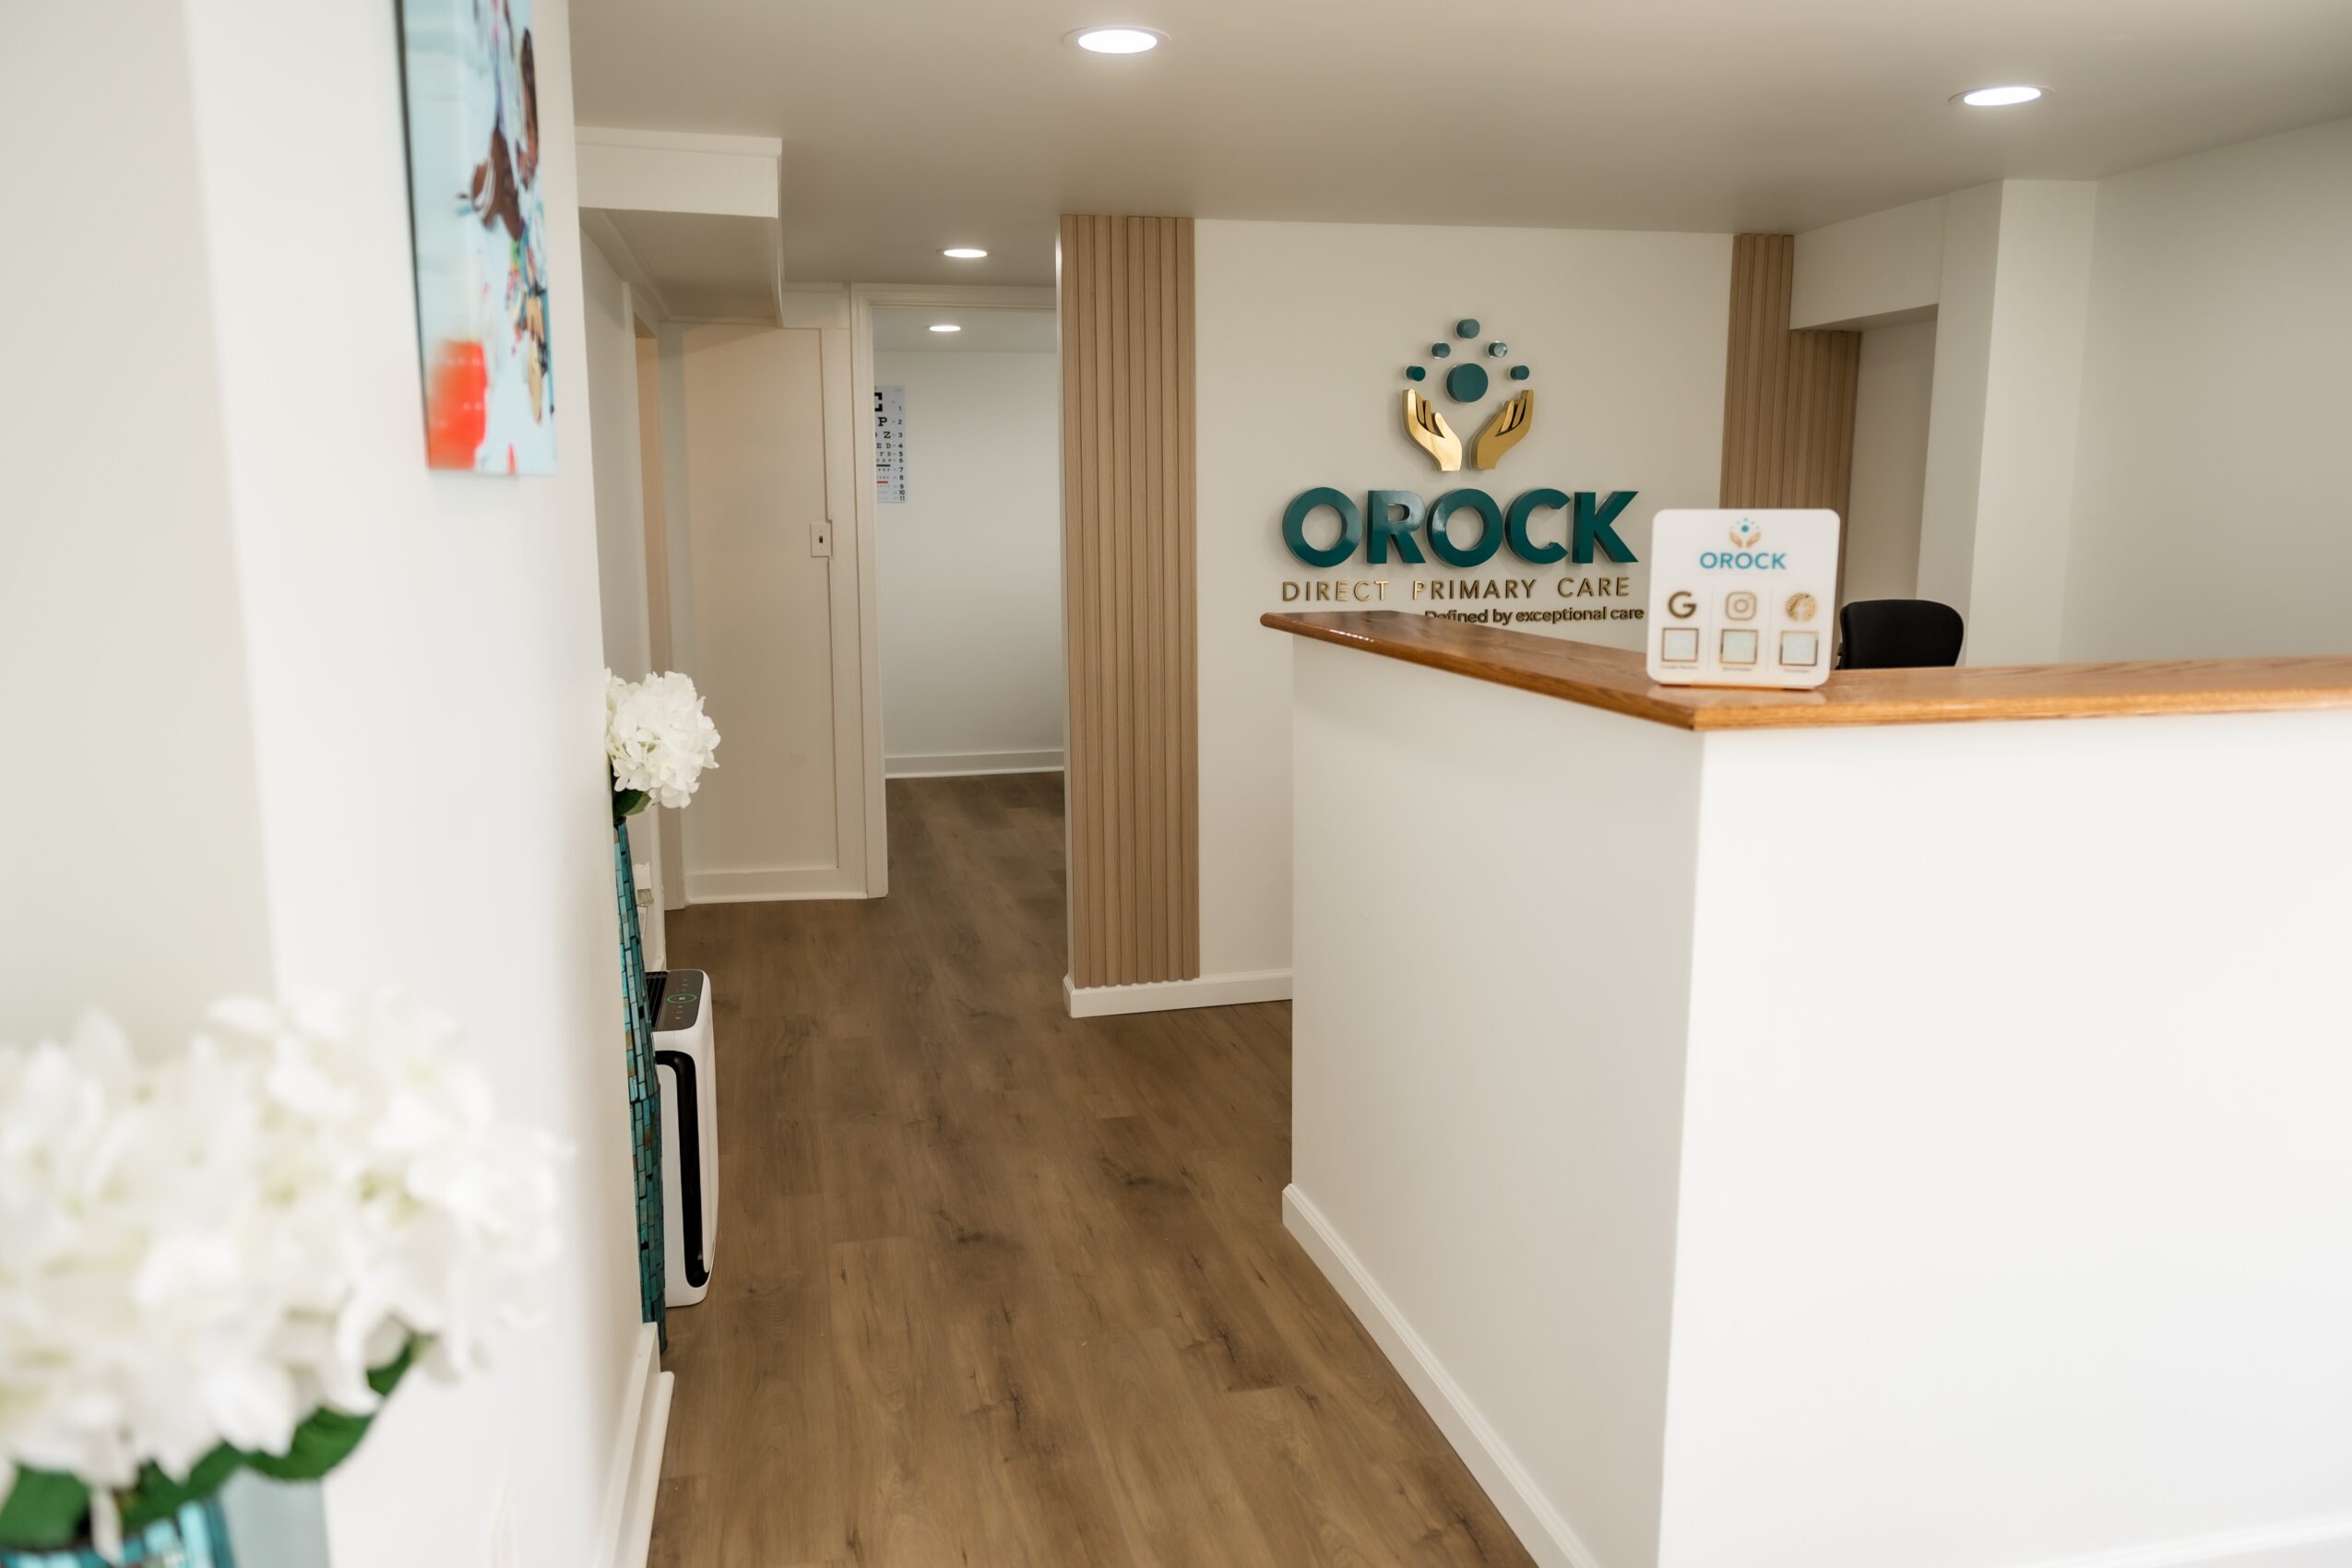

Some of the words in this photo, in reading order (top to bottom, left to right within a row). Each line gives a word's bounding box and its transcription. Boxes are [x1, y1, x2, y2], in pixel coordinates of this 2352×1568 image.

[878, 417, 887, 426] P
[1282, 486, 1639, 567] OROCK
[1700, 552, 1787, 569] OROCK
[1282, 580, 1389, 602] DIRECT
[1412, 578, 1536, 600] PRIMARY
[1558, 576, 1630, 598] CARE
[1492, 608, 1512, 624] by
[1516, 607, 1606, 624] exceptional
[1610, 607, 1644, 620] care
